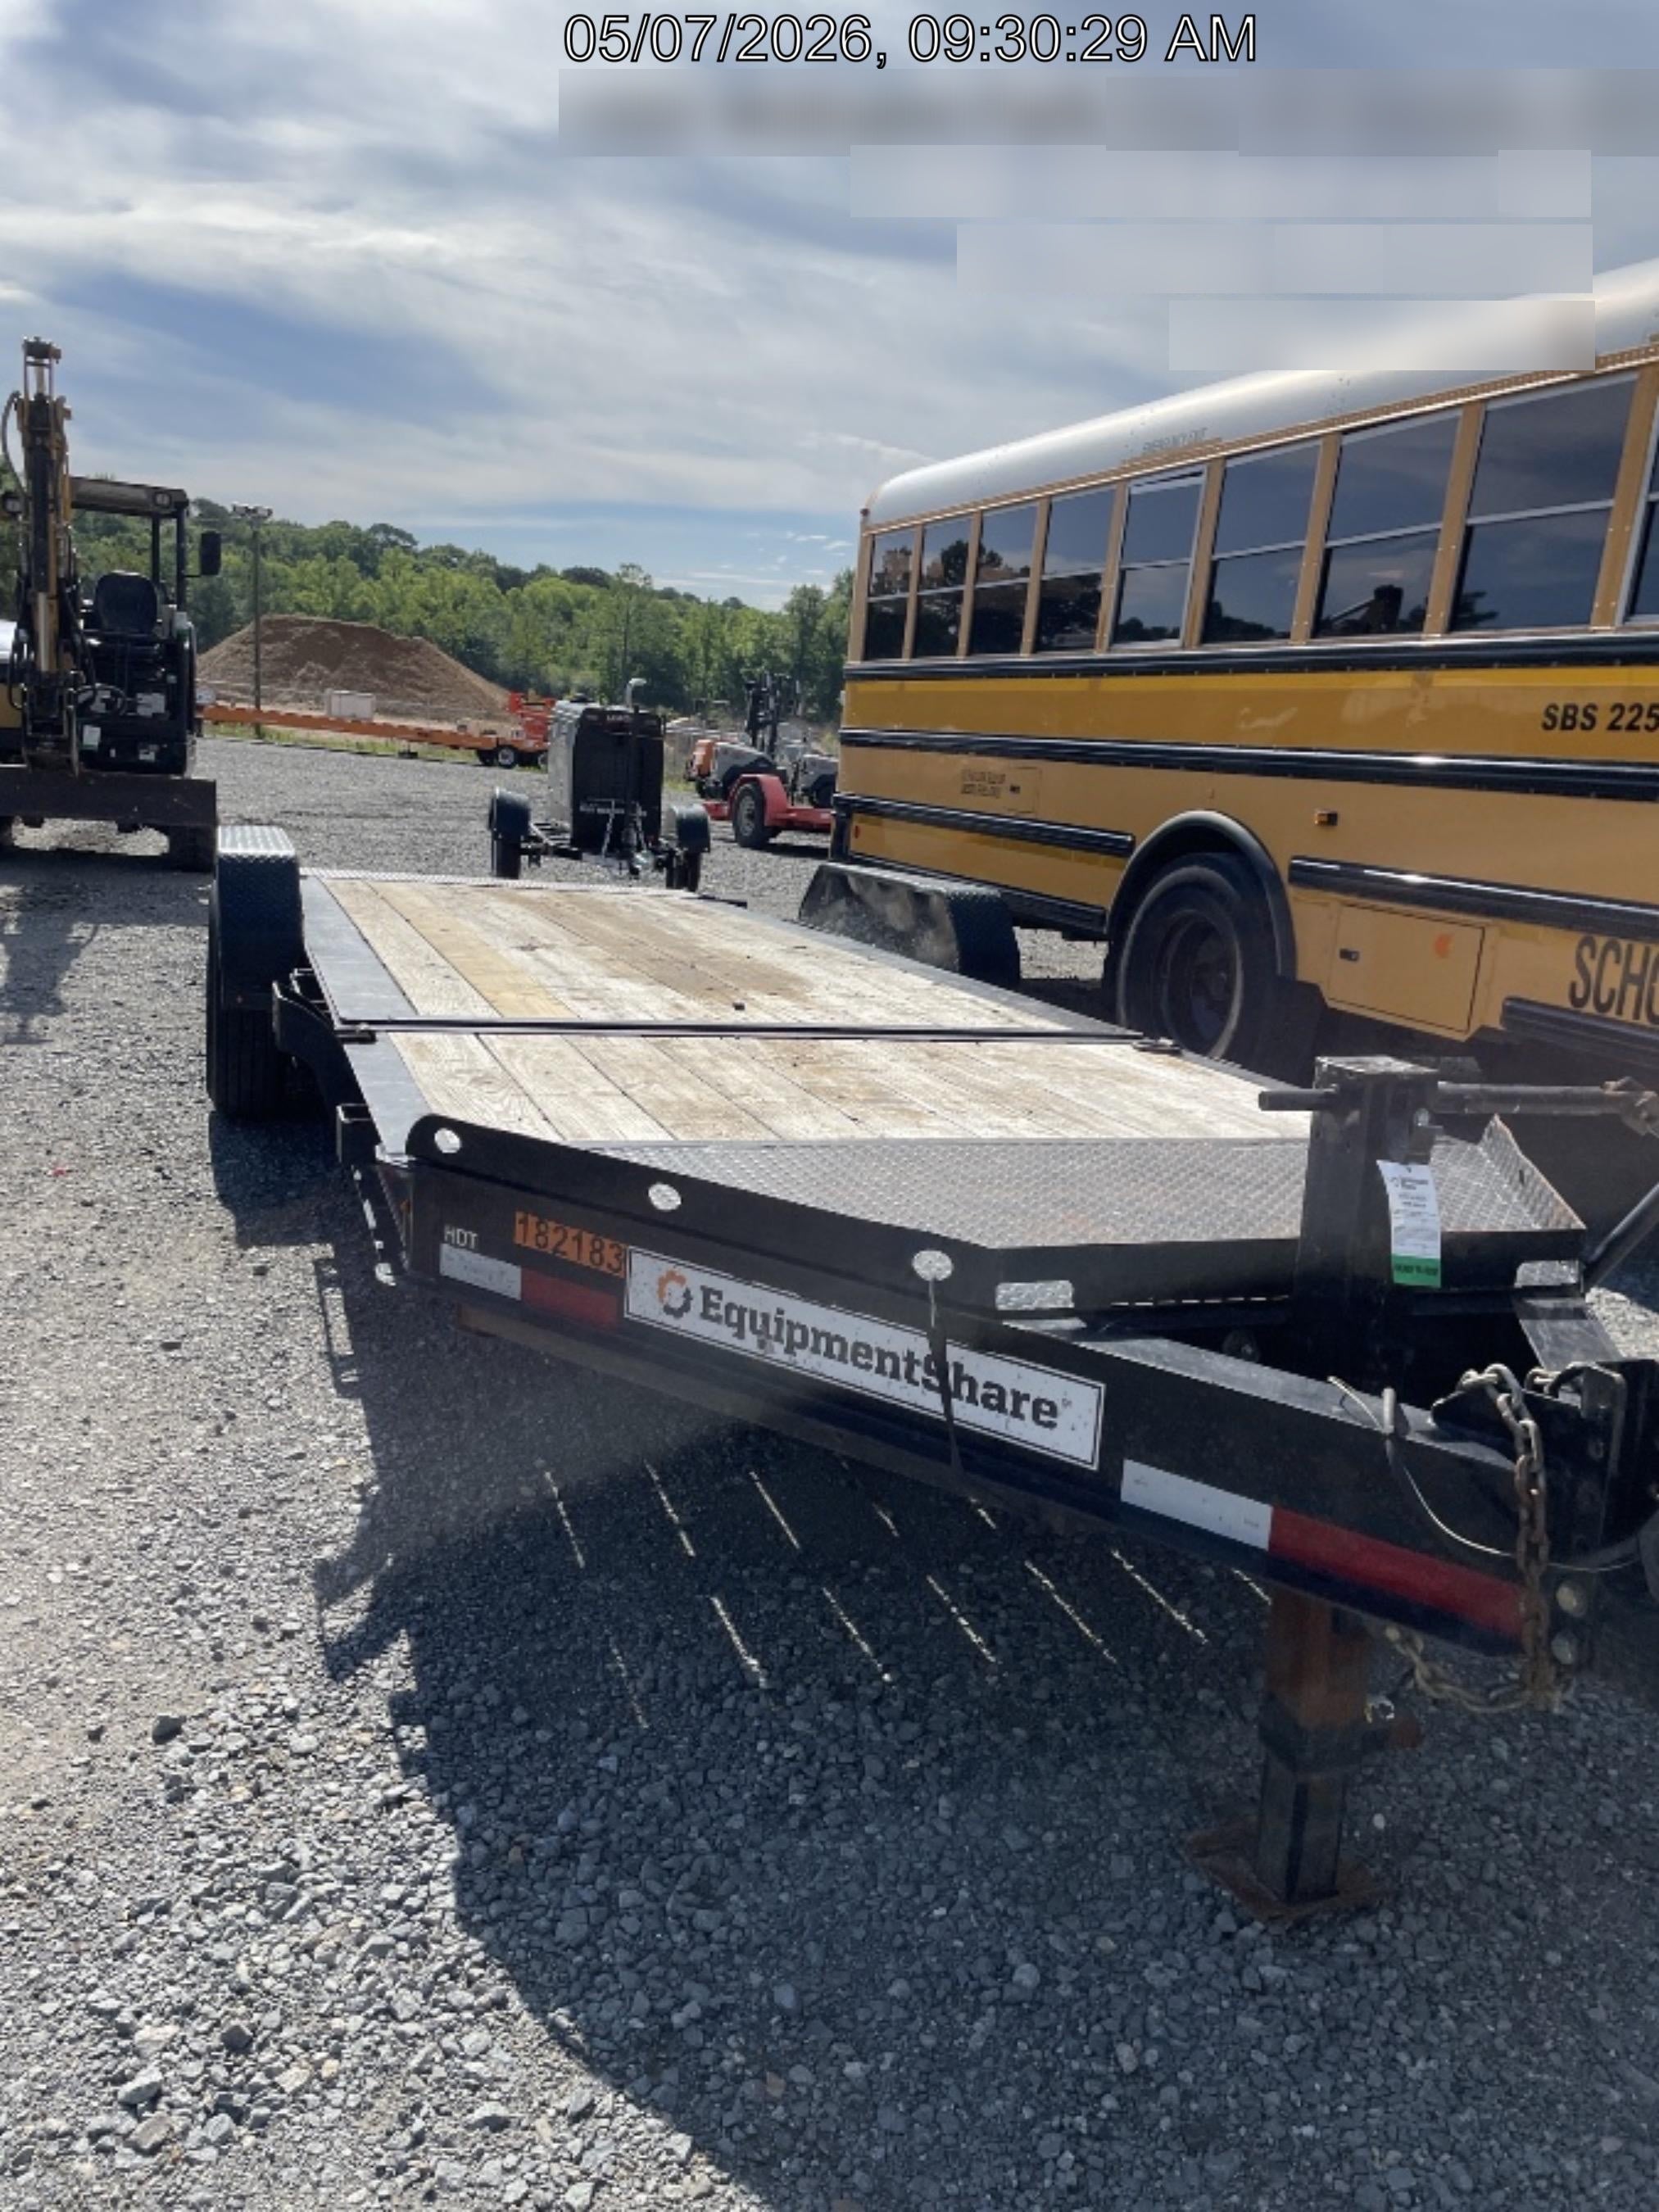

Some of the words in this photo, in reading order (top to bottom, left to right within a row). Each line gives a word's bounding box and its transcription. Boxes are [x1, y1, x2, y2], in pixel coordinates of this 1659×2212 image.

[1542, 703, 1598, 731] SBS
[443, 1226, 478, 1249] HDT
[517, 1215, 624, 1273] 182183
[700, 1284, 1058, 1430] EquipmentShare
